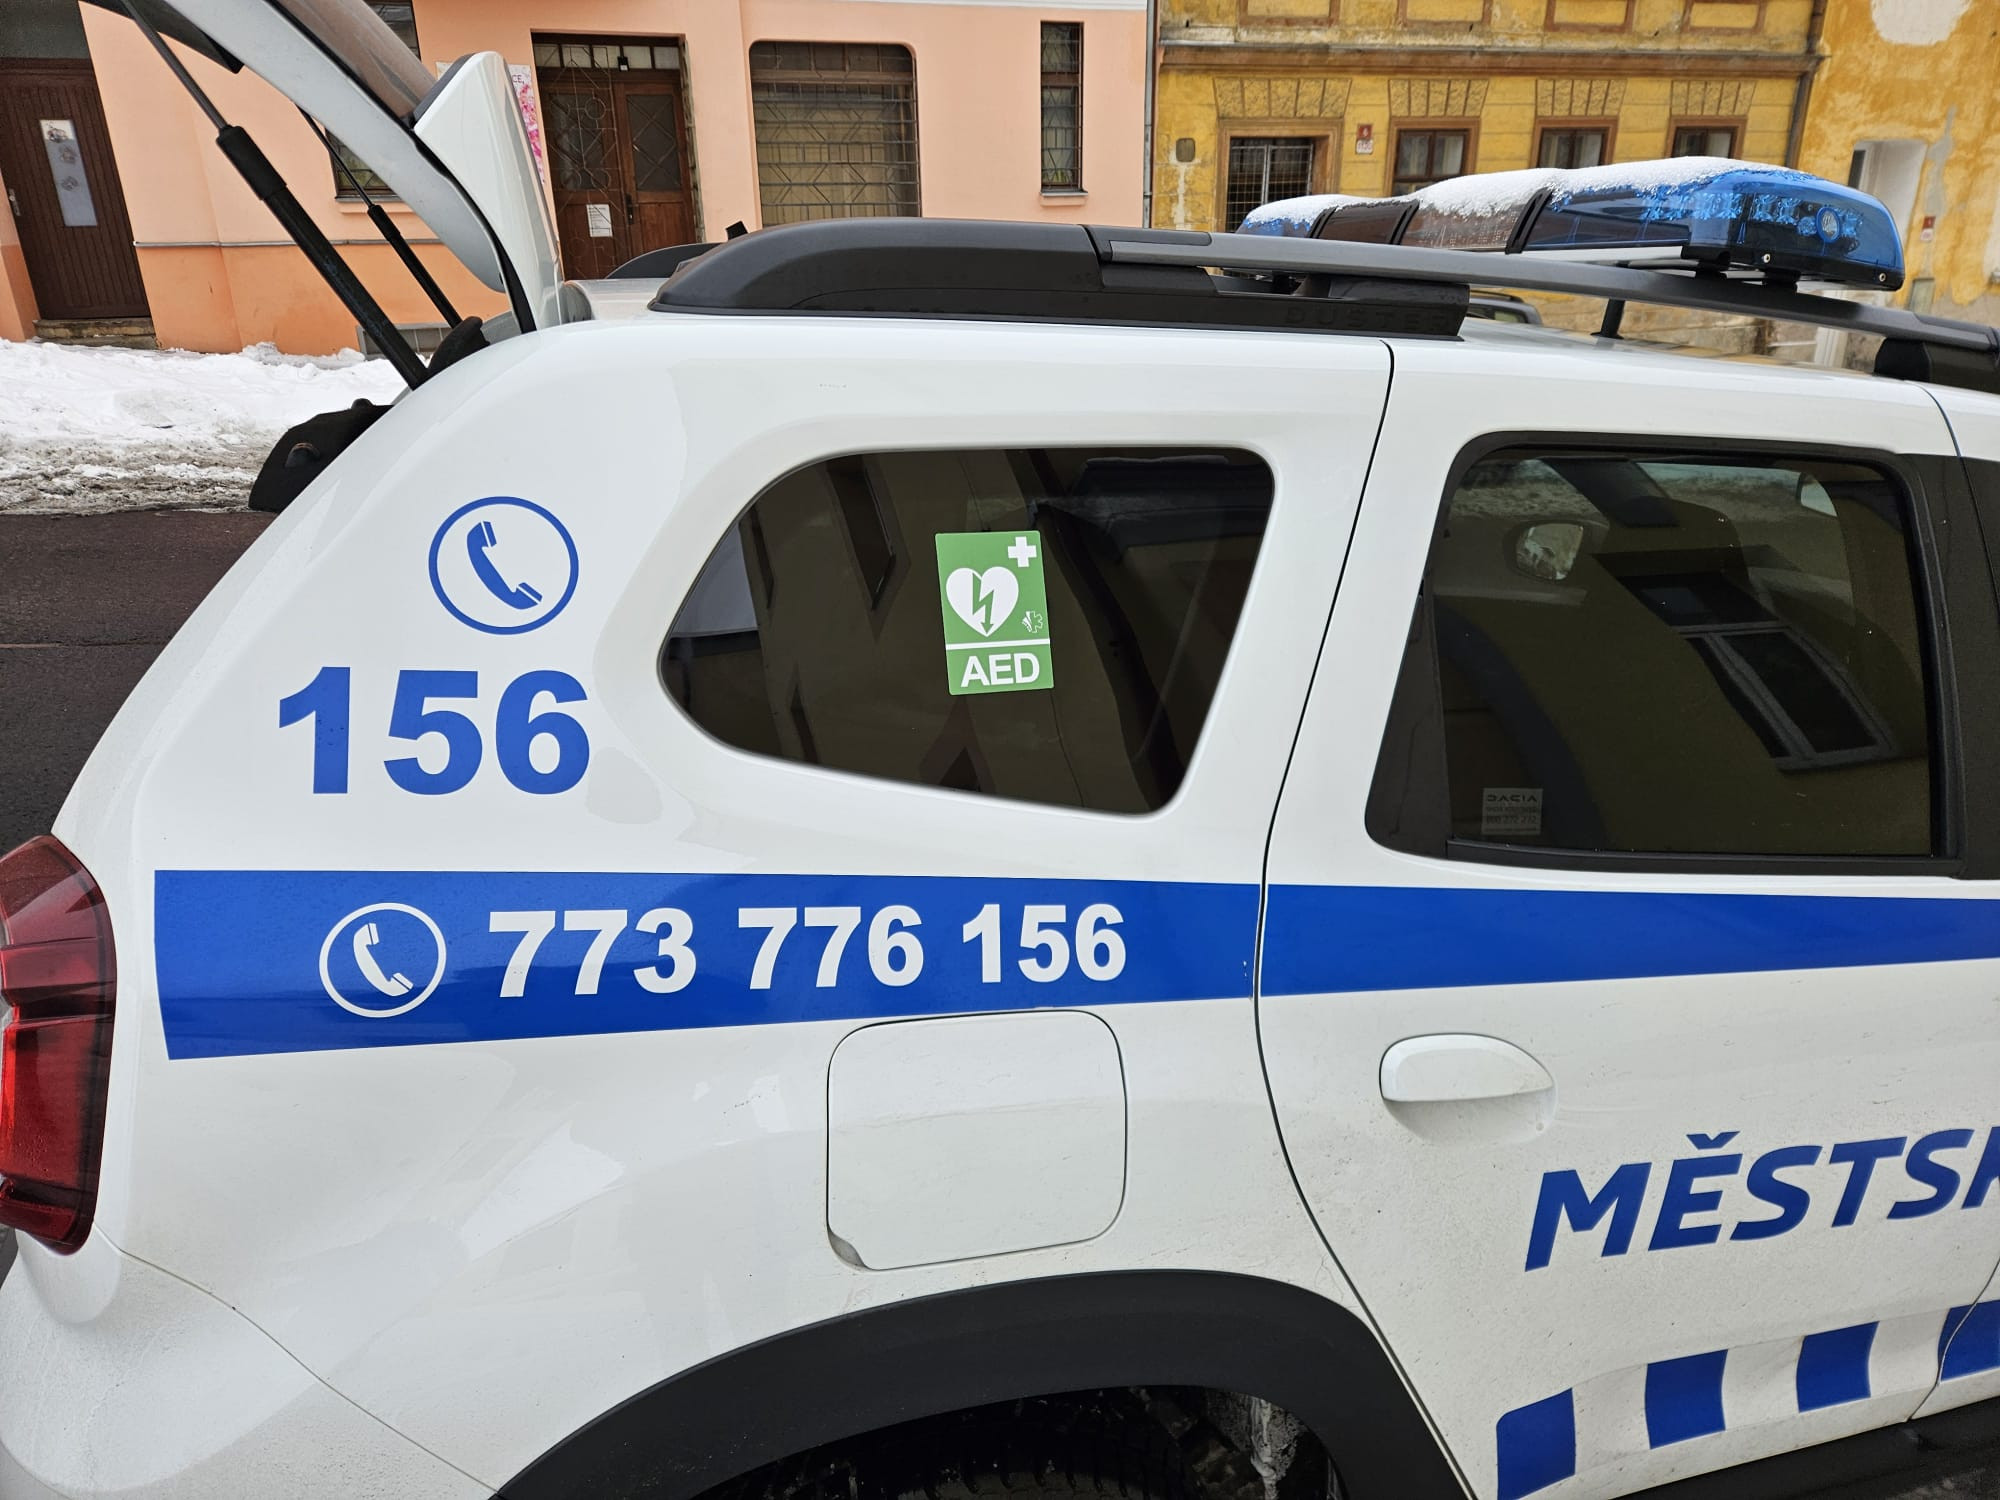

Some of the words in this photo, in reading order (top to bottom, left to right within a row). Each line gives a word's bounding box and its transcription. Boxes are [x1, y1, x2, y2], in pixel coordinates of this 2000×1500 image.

[1287, 306, 1449, 331] DUSTER
[961, 653, 1040, 688] AED
[279, 666, 590, 795] 156
[1488, 794, 1538, 802] DACIA
[489, 908, 697, 998] 773
[739, 905, 924, 990] 776
[962, 904, 1126, 983] 156
